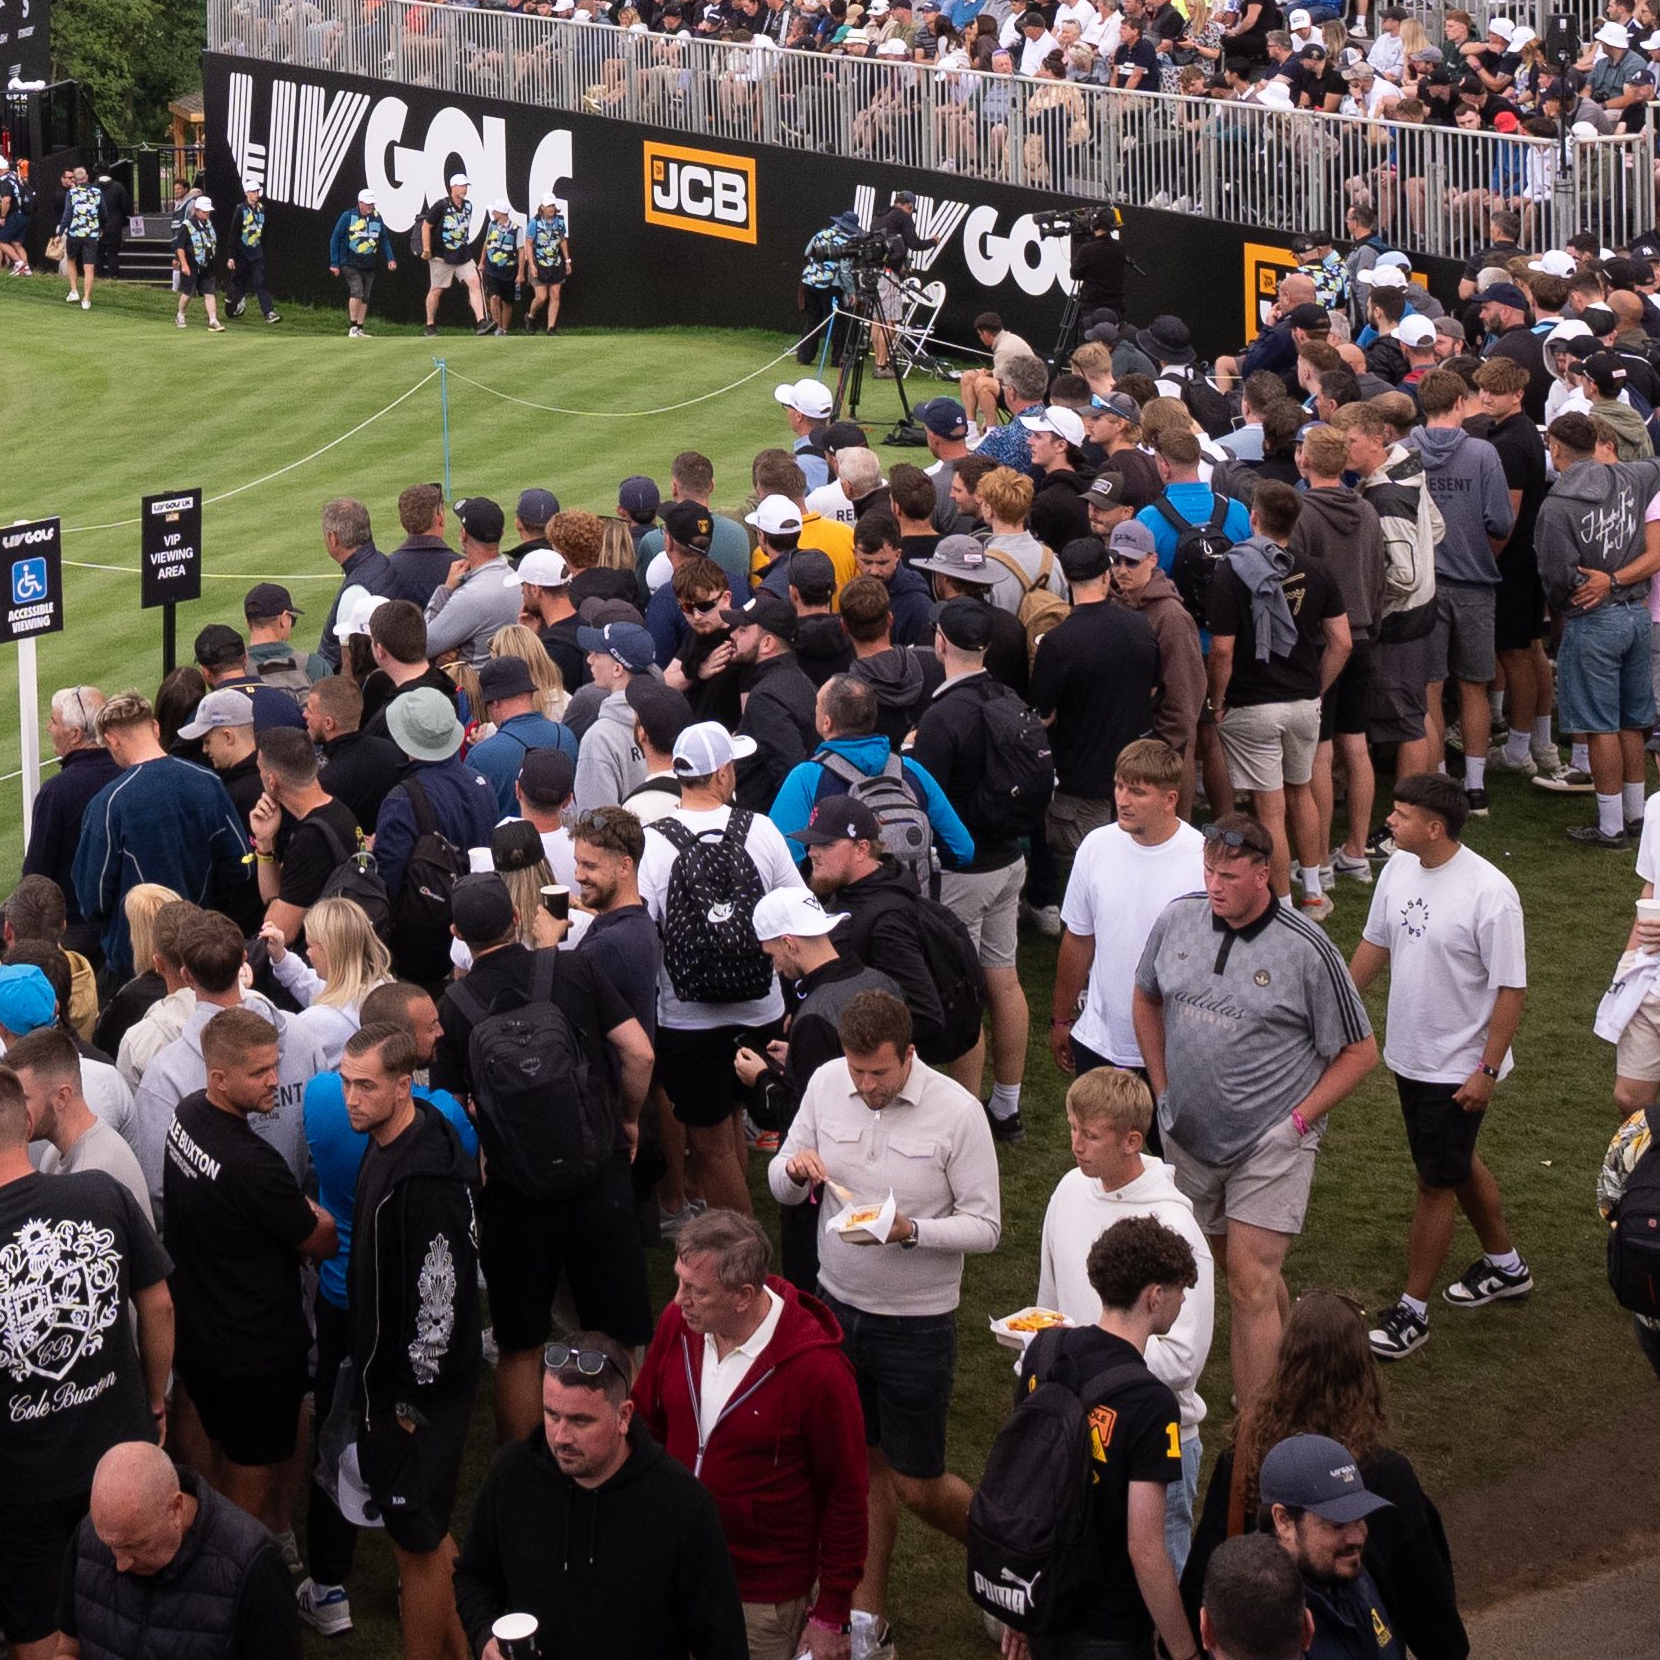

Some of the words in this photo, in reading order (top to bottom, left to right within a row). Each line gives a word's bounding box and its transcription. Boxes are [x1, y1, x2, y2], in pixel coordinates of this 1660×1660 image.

[227, 72, 371, 210] LIV
[364, 95, 574, 242] GOLF
[653, 161, 748, 223] JCB
[24, 527, 55, 546] GOLF
[163, 533, 181, 547] VIP
[150, 547, 193, 565] VIEWING
[158, 564, 186, 580] AREA
[8, 601, 54, 622] ACCESSIBLE
[12, 614, 51, 634] VIEWING
[1174, 987, 1246, 1020] adidas
[178, 1128, 221, 1181] BUXTON
[8, 1388, 51, 1422] Cole
[51, 1371, 117, 1410] Buxton
[1166, 1422, 1182, 1458] 1
[973, 1569, 1026, 1616] PUMA
